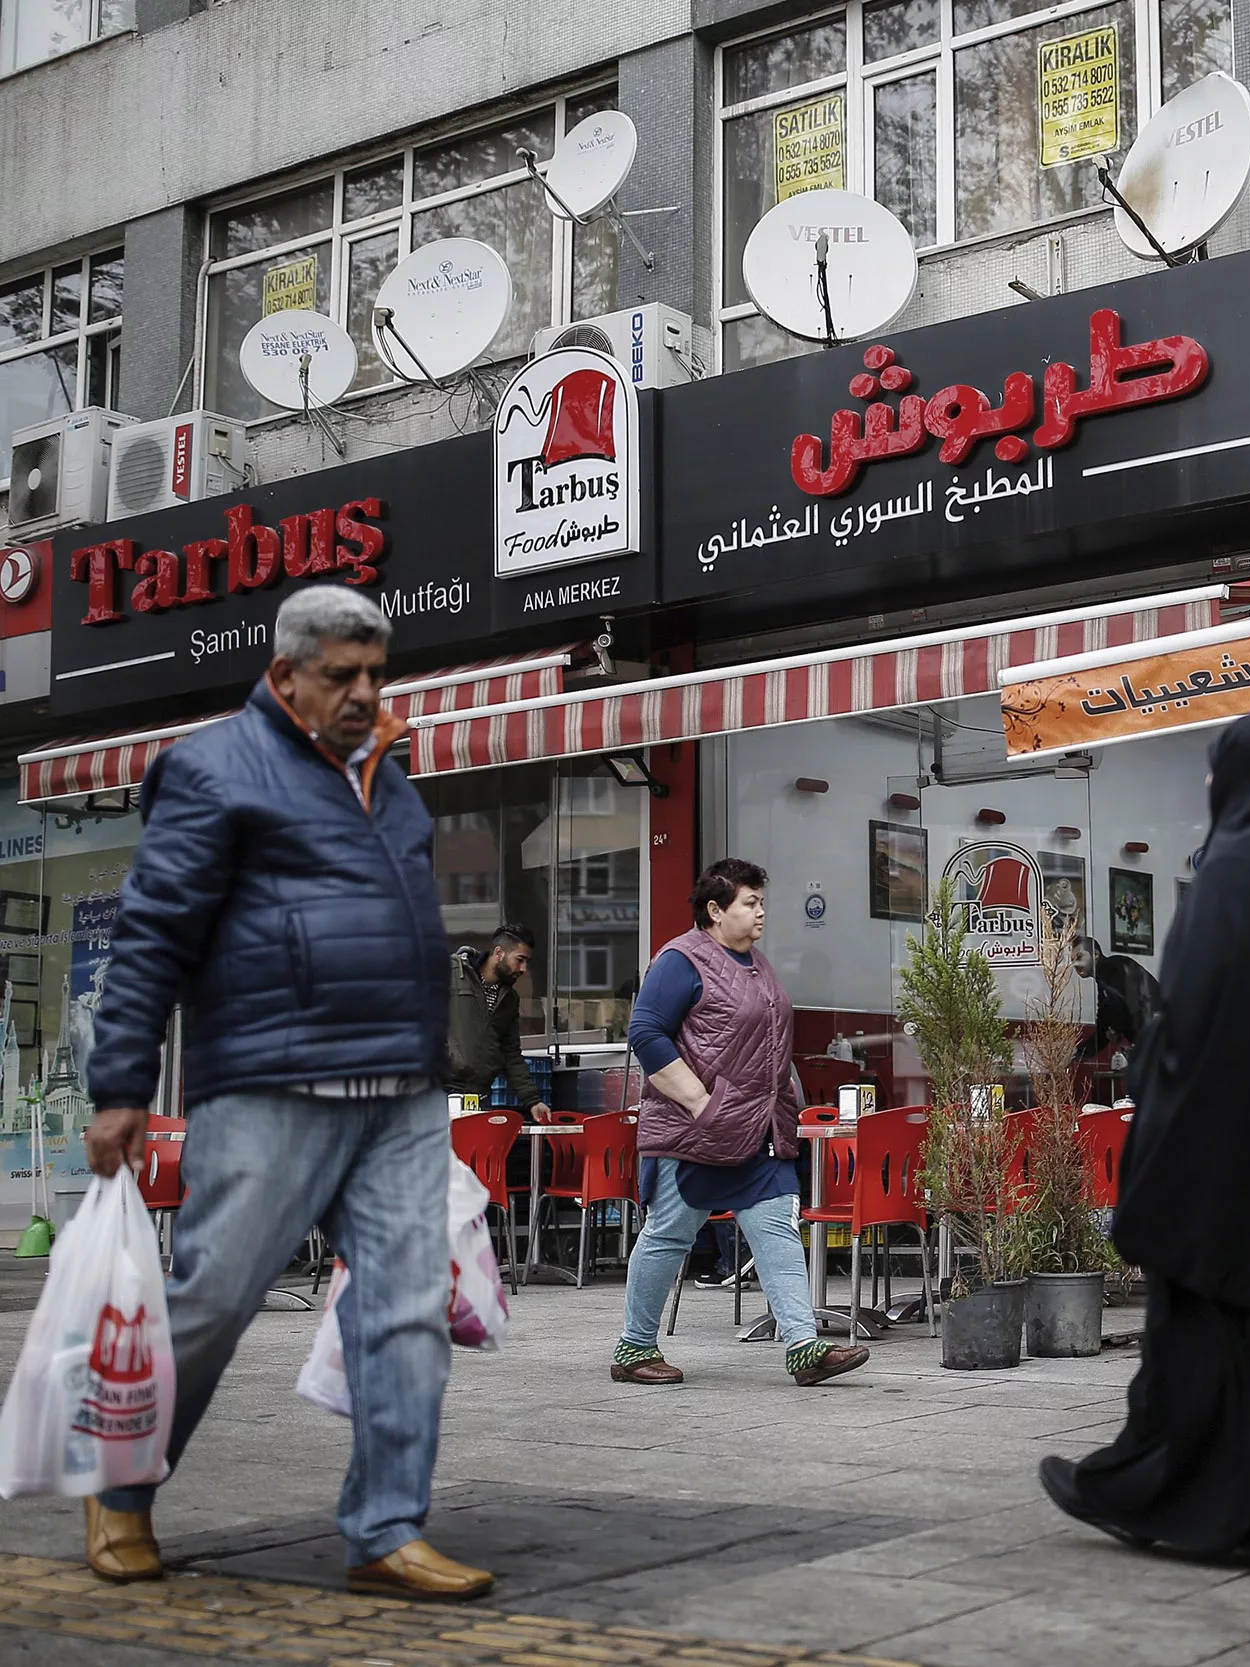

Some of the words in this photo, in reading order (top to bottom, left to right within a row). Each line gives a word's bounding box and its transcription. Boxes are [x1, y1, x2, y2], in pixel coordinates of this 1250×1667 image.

[1043, 34, 1113, 73] KİRALIK
[1043, 80, 1050, 98] 0
[1051, 75, 1069, 96] 532
[1071, 69, 1088, 89] 714
[1090, 63, 1114, 85] 8070
[779, 100, 839, 139] SATILIK
[1044, 102, 1050, 120] 0
[1052, 97, 1069, 118] 555
[1071, 92, 1088, 112] 735
[1090, 85, 1114, 107] 5522
[1079, 116, 1104, 131] EMLAK
[1163, 110, 1224, 149] VESTEL
[779, 146, 784, 163] 0
[785, 141, 801, 161] 532
[802, 135, 818, 156] 714
[819, 129, 840, 151] 8070
[779, 167, 784, 183] 0
[785, 162, 801, 181] 555
[803, 157, 819, 176] 735
[820, 150, 841, 171] 5522
[267, 262, 313, 294] KİRALIK
[443, 266, 483, 287] NextStar
[267, 300, 272, 314] 0
[272, 297, 284, 314] 532
[285, 292, 297, 308] 714
[297, 287, 313, 305] 8070
[262, 340, 291, 350] EFSANE
[262, 348, 288, 357] 530
[292, 345, 310, 355] 06
[312, 344, 329, 353] 71
[632, 312, 643, 383] BEKO
[791, 308, 1210, 497] طربوش
[176, 431, 187, 485] VESTEL
[507, 454, 620, 513] Tarbuş
[944, 455, 1054, 523] المطبخ
[560, 514, 620, 548] طربوش
[829, 480, 933, 547] السوري
[504, 518, 567, 557] Food
[697, 503, 819, 573] العثماني
[70, 497, 386, 627] Tarbuş
[380, 577, 472, 619] Mutfağı
[523, 589, 555, 612] ANA
[558, 576, 620, 606] MERKEZ
[987, 940, 1035, 958] طربوش
[10, 1166, 42, 1179] swissir
